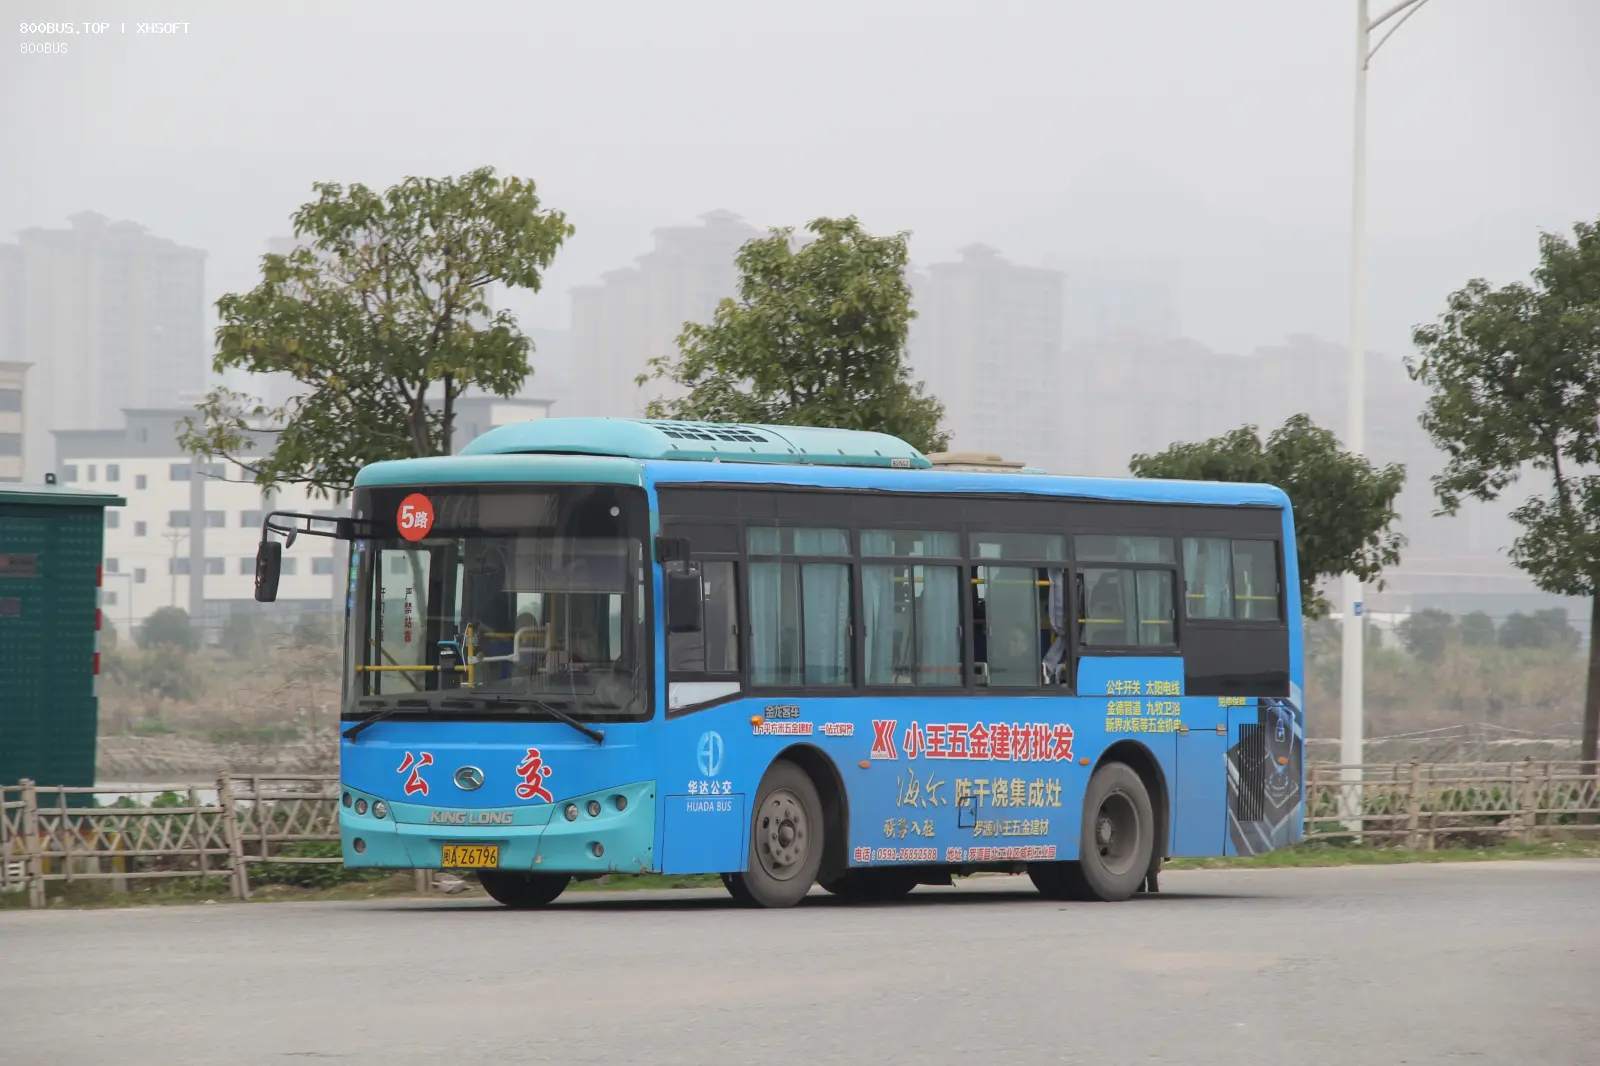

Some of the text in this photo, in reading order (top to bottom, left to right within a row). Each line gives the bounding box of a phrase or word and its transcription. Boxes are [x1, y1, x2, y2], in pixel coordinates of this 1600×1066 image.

[401, 505, 428, 529] 5路
[1106, 680, 1181, 696] 公牛开关 太阳电线
[765, 705, 800, 719] 金龙客车
[1106, 700, 1181, 716] 金德管道 九牧卫浴
[1105, 717, 1182, 733] 新界水泵等五金机电
[903, 720, 1074, 762] 小王五金建材批发
[397, 748, 553, 803] 公 交
[687, 780, 732, 795] 华达公交
[955, 778, 1062, 808] 防干烧集成灶
[686, 801, 732, 812] HUADA BUS
[429, 811, 513, 824] KING LONG
[973, 819, 1050, 837] 罗源小王五金建材
